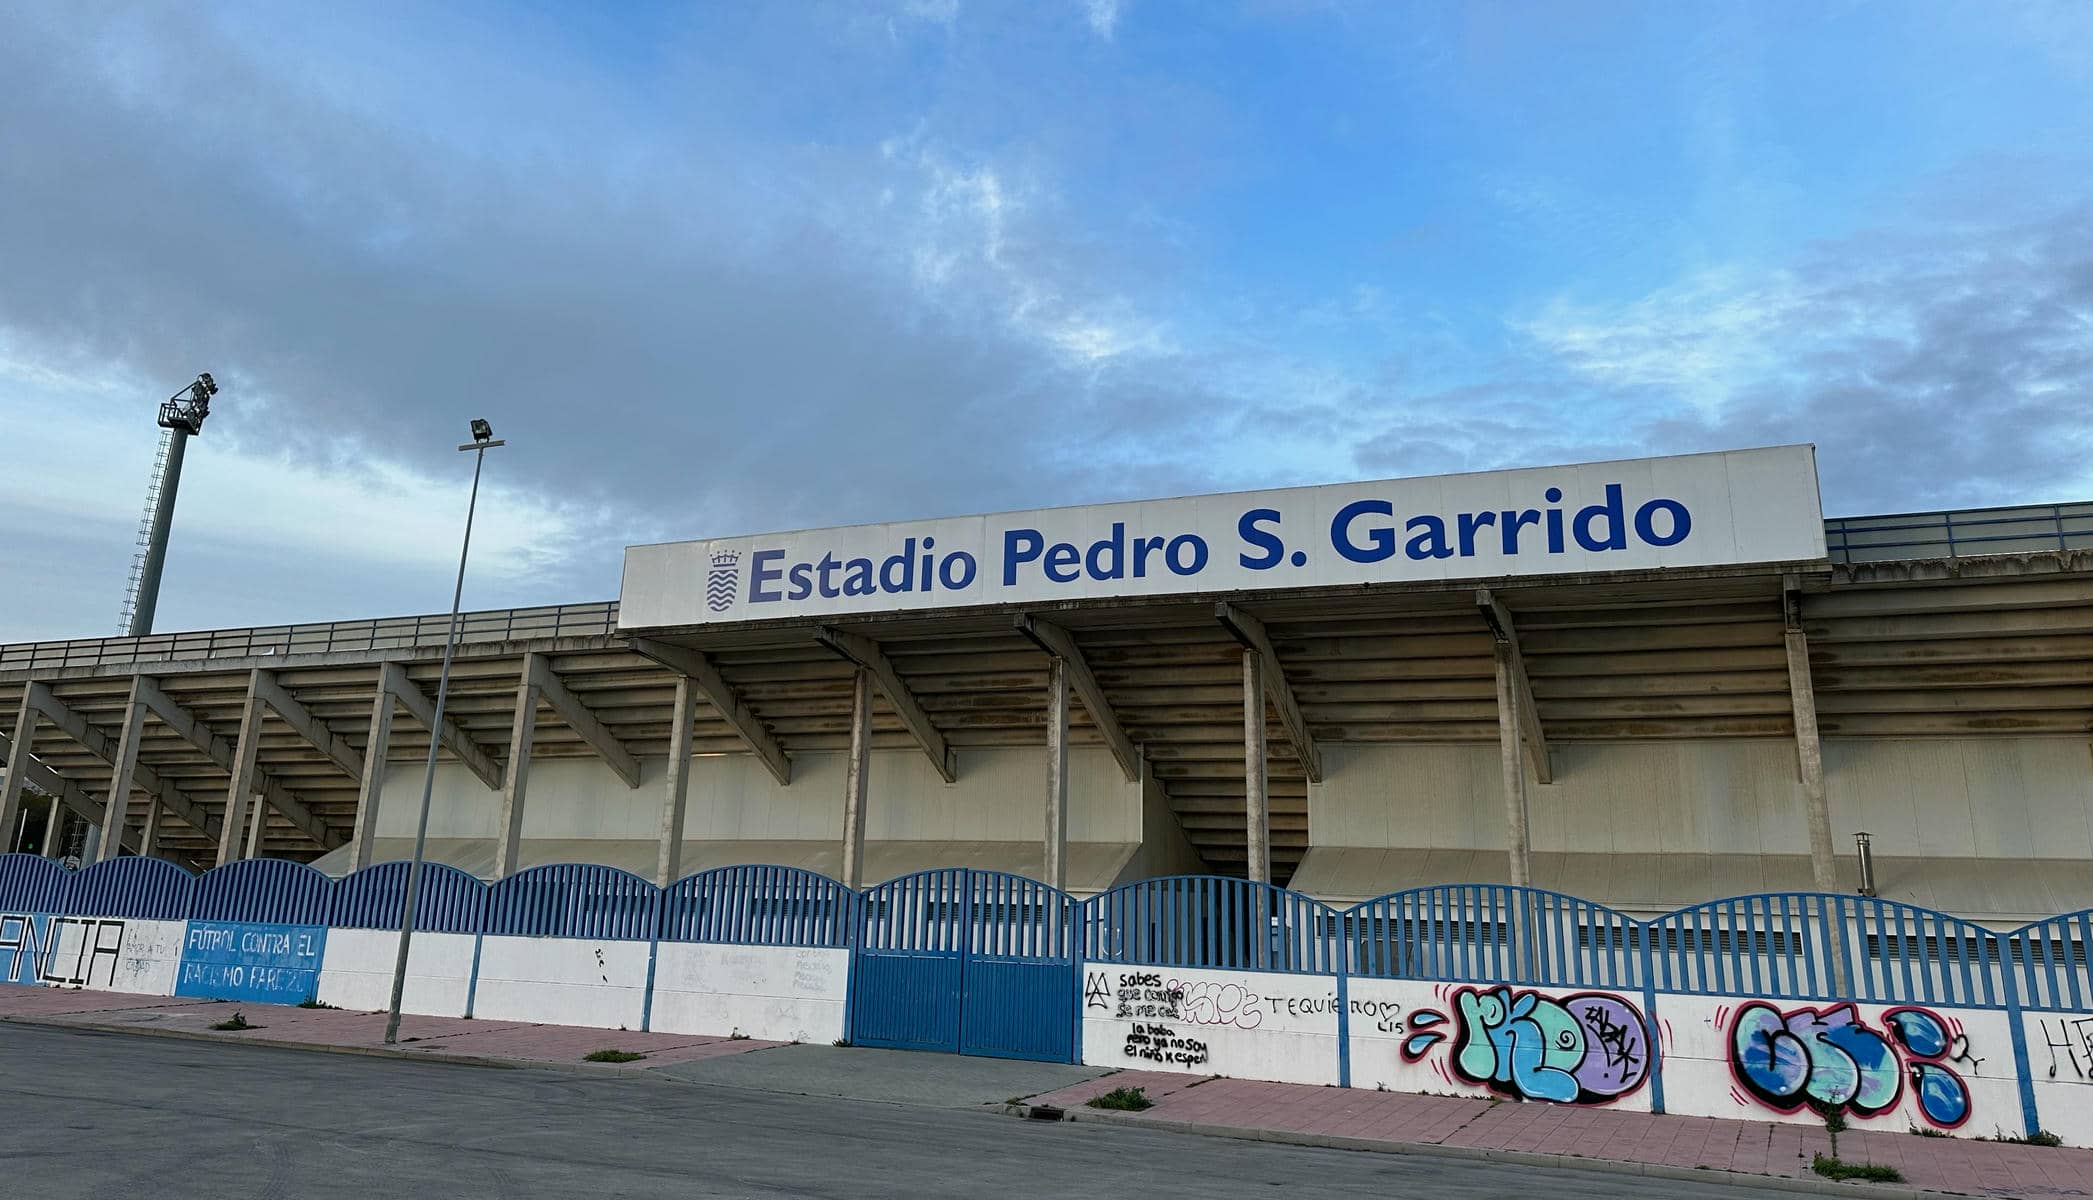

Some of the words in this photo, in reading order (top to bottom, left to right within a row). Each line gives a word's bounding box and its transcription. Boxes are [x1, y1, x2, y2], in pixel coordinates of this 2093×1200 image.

[748, 537, 977, 603] Estadio
[1003, 522, 1209, 586] Pedro
[1238, 508, 1307, 571] S.
[1330, 483, 1692, 564] Garrido
[241, 932, 290, 954] CONTRA
[297, 934, 315, 956] EL
[1132, 1022, 1145, 1034] la
[1124, 1044, 1137, 1057] el
[1153, 1037, 1168, 1051] ya
[1171, 1038, 1185, 1049] no
